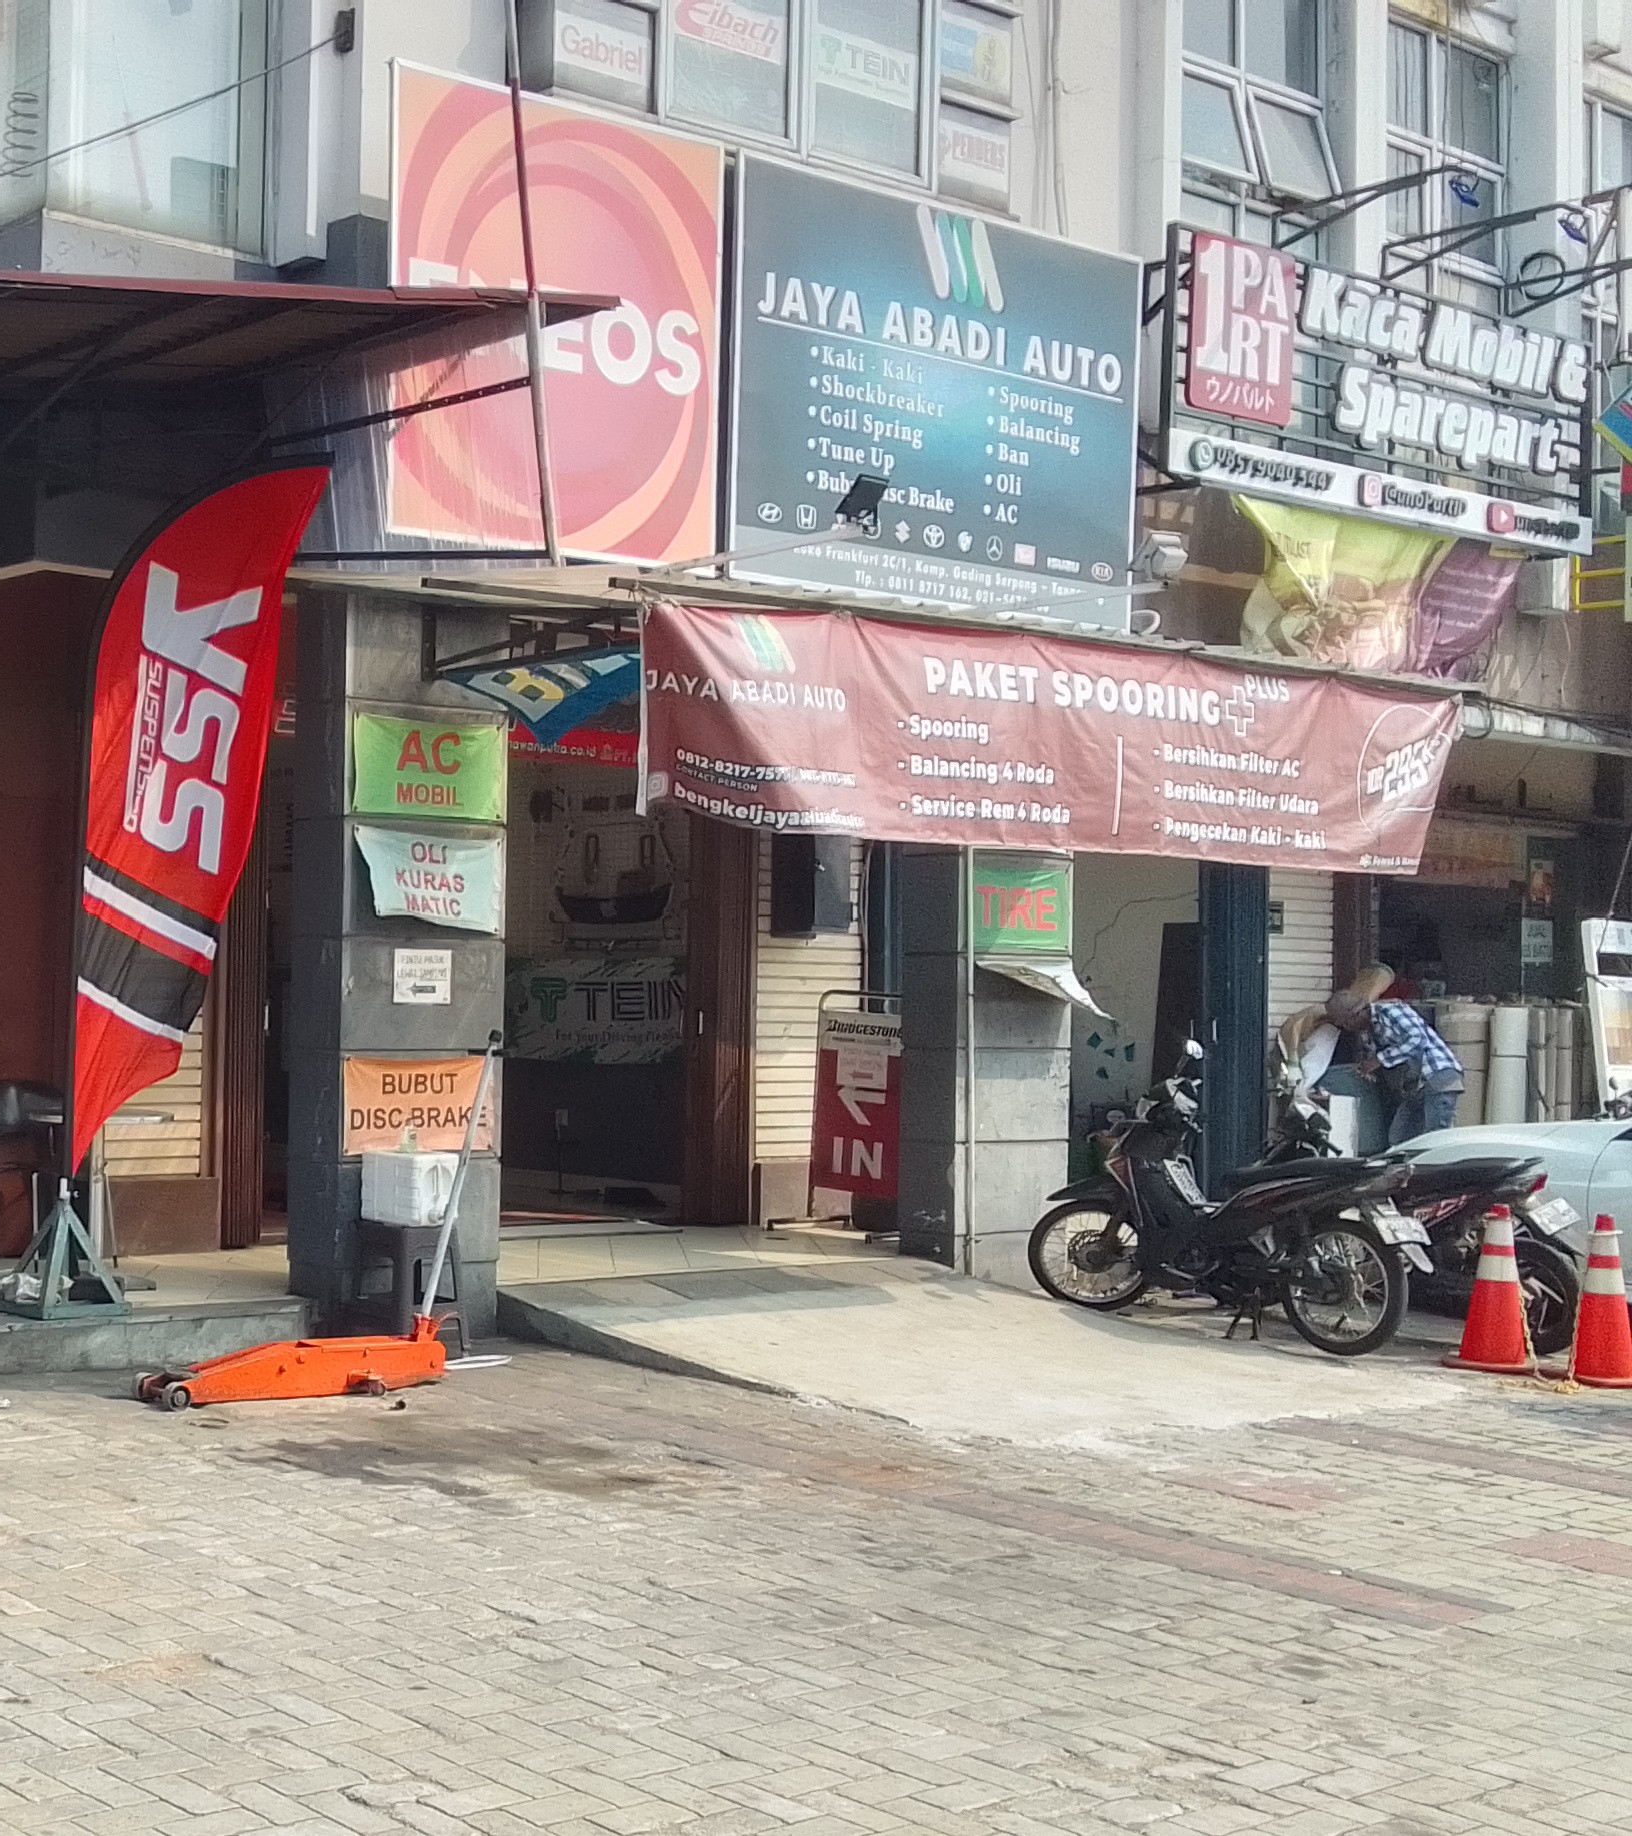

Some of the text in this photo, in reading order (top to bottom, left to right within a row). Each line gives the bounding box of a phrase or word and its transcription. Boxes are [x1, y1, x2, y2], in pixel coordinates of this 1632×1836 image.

[560, 24, 644, 74] Gabriel
[845, 43, 911, 86] TEIN
[409, 257, 701, 396] EOS
[757, 272, 1123, 395] JAYA ABADI AUTO
[1304, 267, 1588, 403] Kaca Mobil &
[821, 346, 865, 372] Kaki
[882, 357, 923, 385] Kaki
[821, 374, 945, 419] Shockbreaker
[999, 386, 1074, 425] Spooring
[819, 405, 923, 449] Coil Spring
[998, 416, 1081, 455] Balancing
[1335, 365, 1561, 473] Sparepart
[819, 436, 895, 474] Tune Up
[997, 443, 1030, 466] Ban
[908, 487, 955, 514] Brake
[996, 474, 1022, 497] Oli
[994, 502, 1018, 524] AC
[645, 669, 847, 711] JAYA ABADI AUTO
[923, 656, 1290, 726] PAKET SPOORING PLUS
[909, 714, 989, 745] Spooring
[396, 730, 462, 775] AC
[910, 755, 1055, 787] Balancing 4 Roda
[1163, 743, 1301, 779] Bersihkan Filter AC
[396, 782, 462, 807] MOBIL
[717, 777, 759, 793] PERSON
[1163, 780, 1319, 816] Bersihkan Filter Udara
[911, 795, 1071, 825] Service Rem 4 Roda
[1163, 816, 1247, 845] Pengecekan
[1249, 825, 1282, 847] Kaki
[1294, 828, 1327, 850] kaki
[410, 841, 449, 866] OLI
[395, 868, 465, 893] KURAS
[404, 892, 462, 917] MATIC
[976, 885, 1058, 931] TIRE
[574, 981, 685, 1022] TEIN
[825, 1019, 903, 1039] BRIDGESTONE
[382, 1073, 458, 1095] BUBUT
[350, 1107, 488, 1131] DISC BRAKE
[832, 1135, 885, 1180] IN
